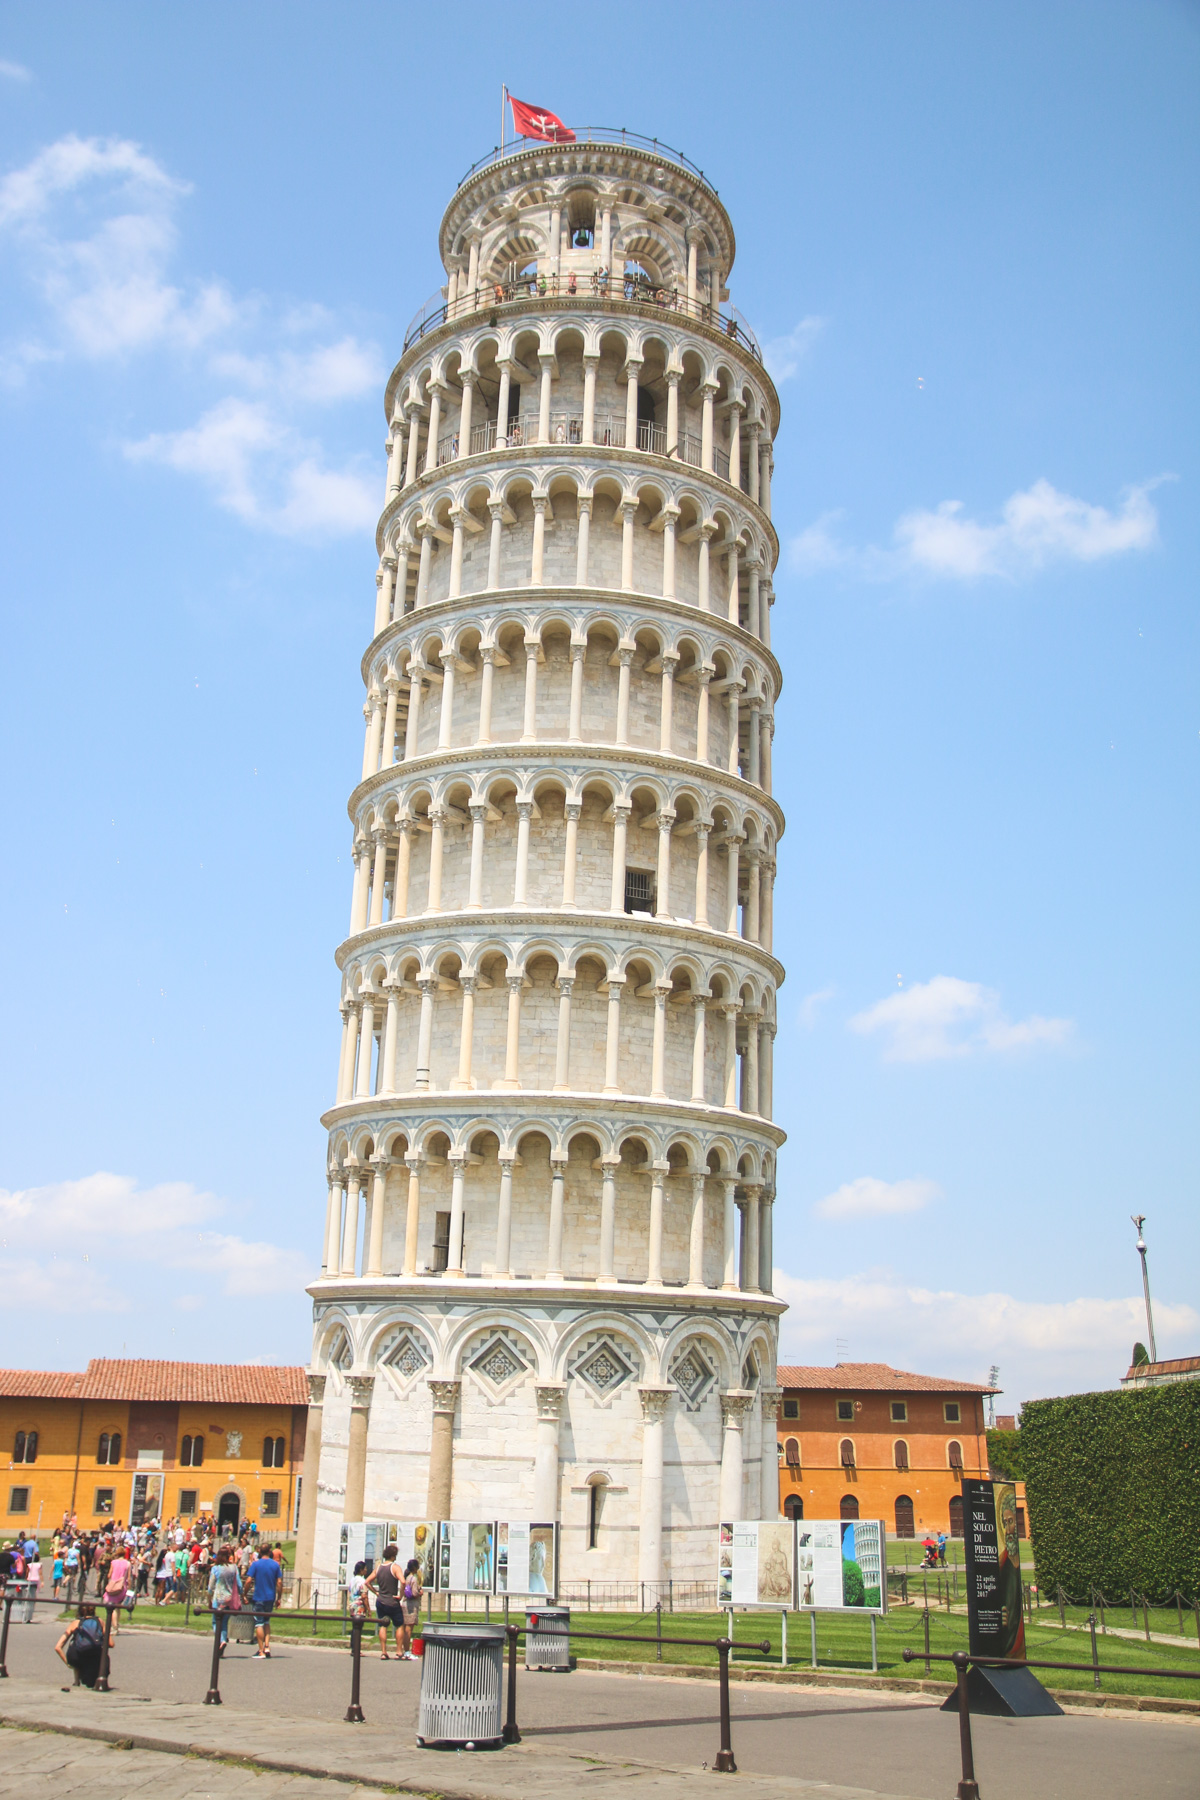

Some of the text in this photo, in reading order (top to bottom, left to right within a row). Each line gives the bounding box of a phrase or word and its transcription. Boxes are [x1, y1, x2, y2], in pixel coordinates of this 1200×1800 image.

[972, 1511, 986, 1520] NEL
[973, 1522, 994, 1532] SOLCO
[974, 1533, 982, 1543] DI
[974, 1545, 997, 1554] PIETRO
[983, 1574, 996, 1583] aprile
[983, 1583, 996, 1591] luglio
[977, 1590, 988, 1598] 2017
